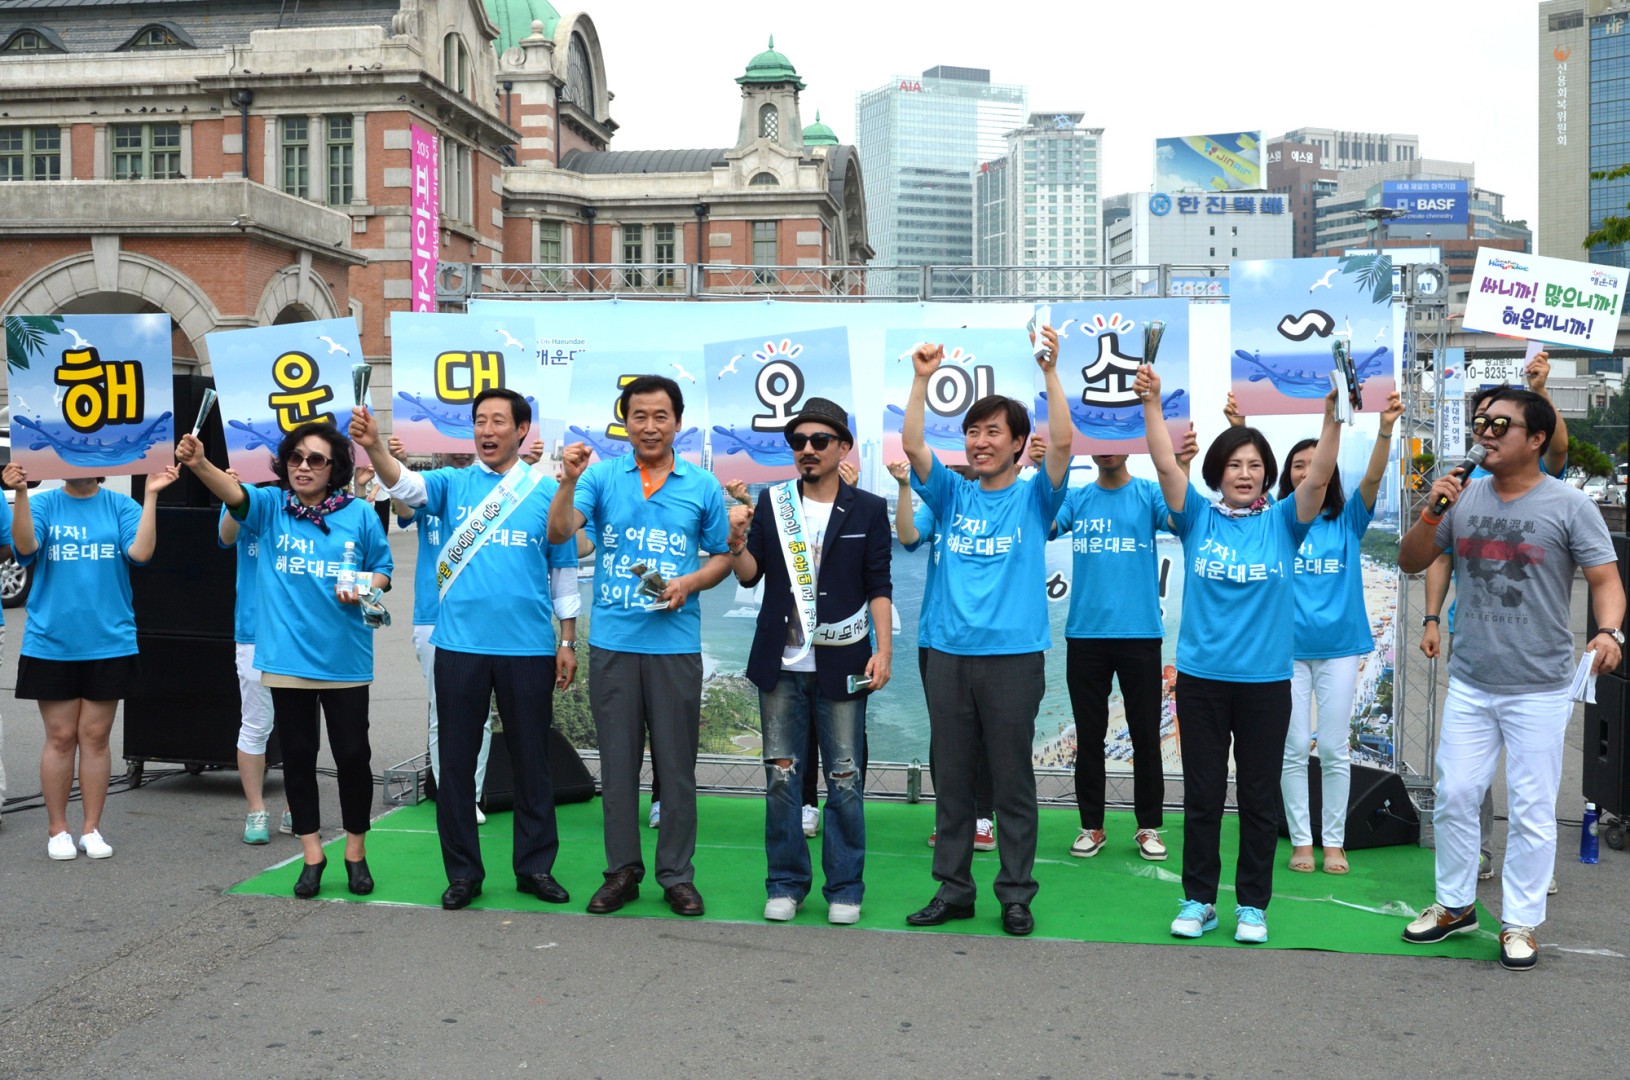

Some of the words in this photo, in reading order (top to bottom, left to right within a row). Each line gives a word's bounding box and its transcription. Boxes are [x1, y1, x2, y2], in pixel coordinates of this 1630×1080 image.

[899, 80, 922, 92] AIA
[1557, 63, 1567, 146] 신용회복위원회
[1266, 151, 1281, 163] 스원
[1291, 150, 1313, 163] 에스원
[1417, 199, 1456, 210] BASF
[1480, 276, 1539, 303] 싸니까!
[1545, 283, 1619, 316] 많으니까!
[1502, 305, 1595, 340] 해운대니까!
[434, 350, 506, 405] 대
[1081, 332, 1144, 408] 소
[54, 346, 145, 434] 해
[269, 350, 338, 434] 운
[751, 359, 805, 433] 오
[925, 364, 995, 418] 이
[49, 525, 87, 540] 가자!
[1074, 517, 1112, 534] 가자!
[48, 543, 121, 561] 해운대로
[276, 533, 314, 554] 가자!
[625, 527, 688, 557] 여름엔
[787, 541, 815, 601] 해운대로
[1479, 614, 1529, 624] REGRETS
